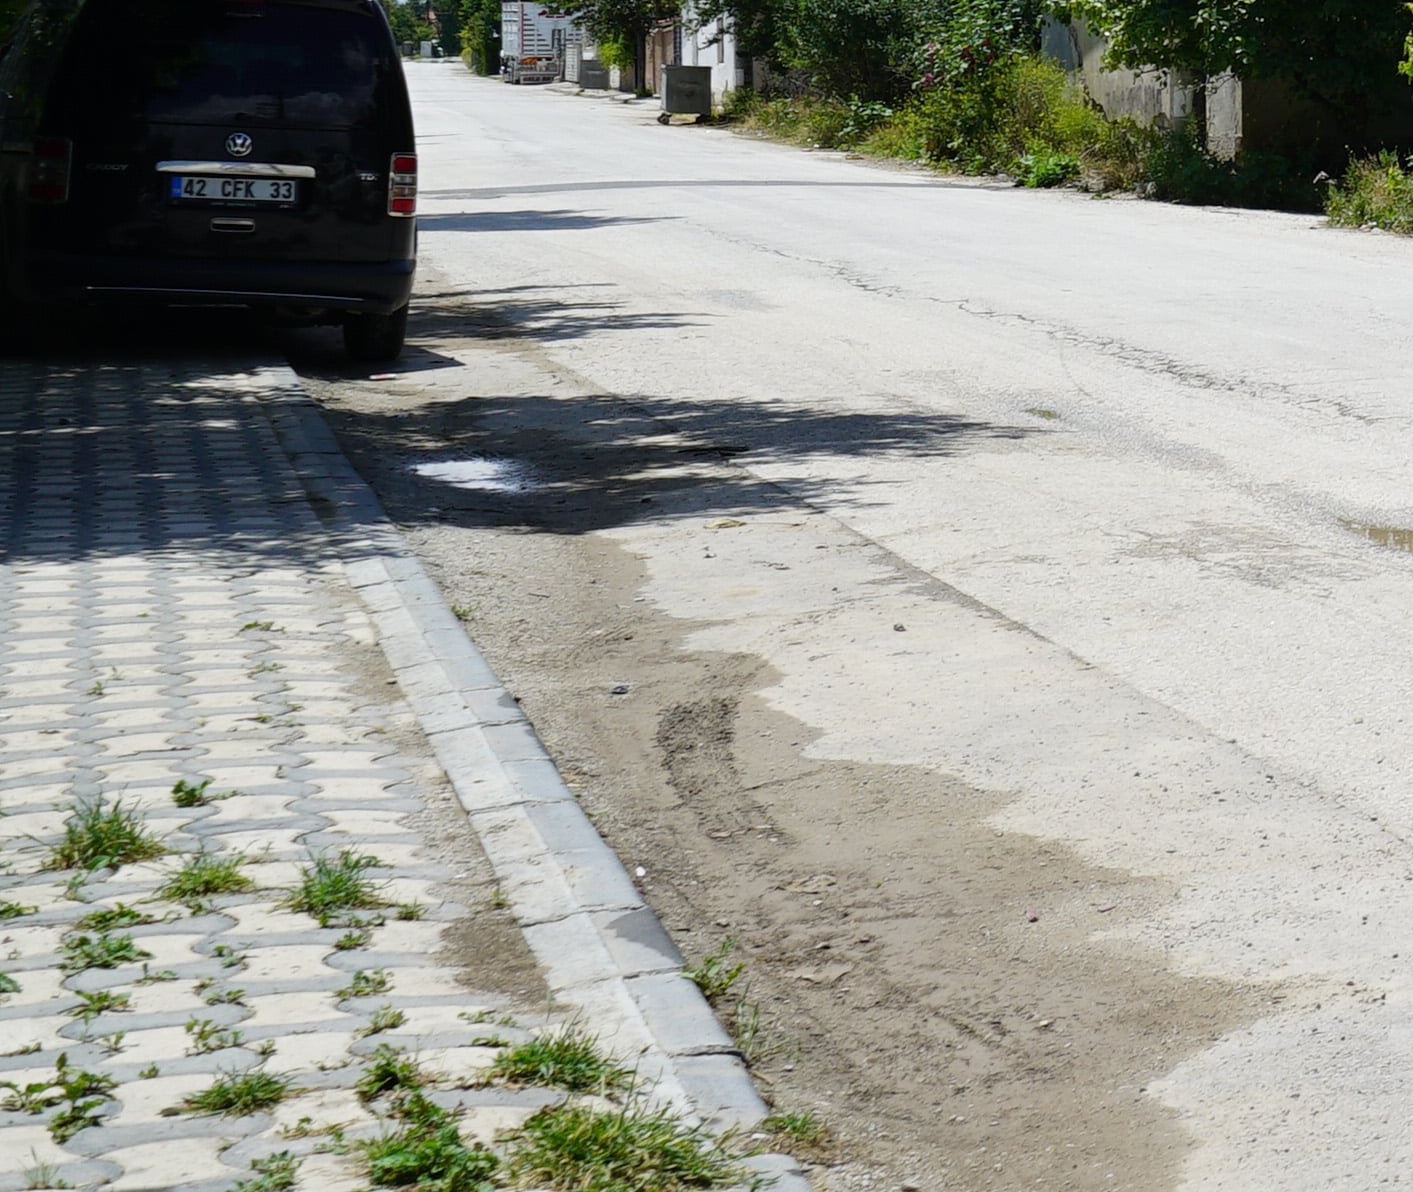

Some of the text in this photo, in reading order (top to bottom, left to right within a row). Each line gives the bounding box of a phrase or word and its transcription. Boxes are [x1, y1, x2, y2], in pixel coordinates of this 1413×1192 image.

[183, 178, 294, 200] 42 CFK 33
